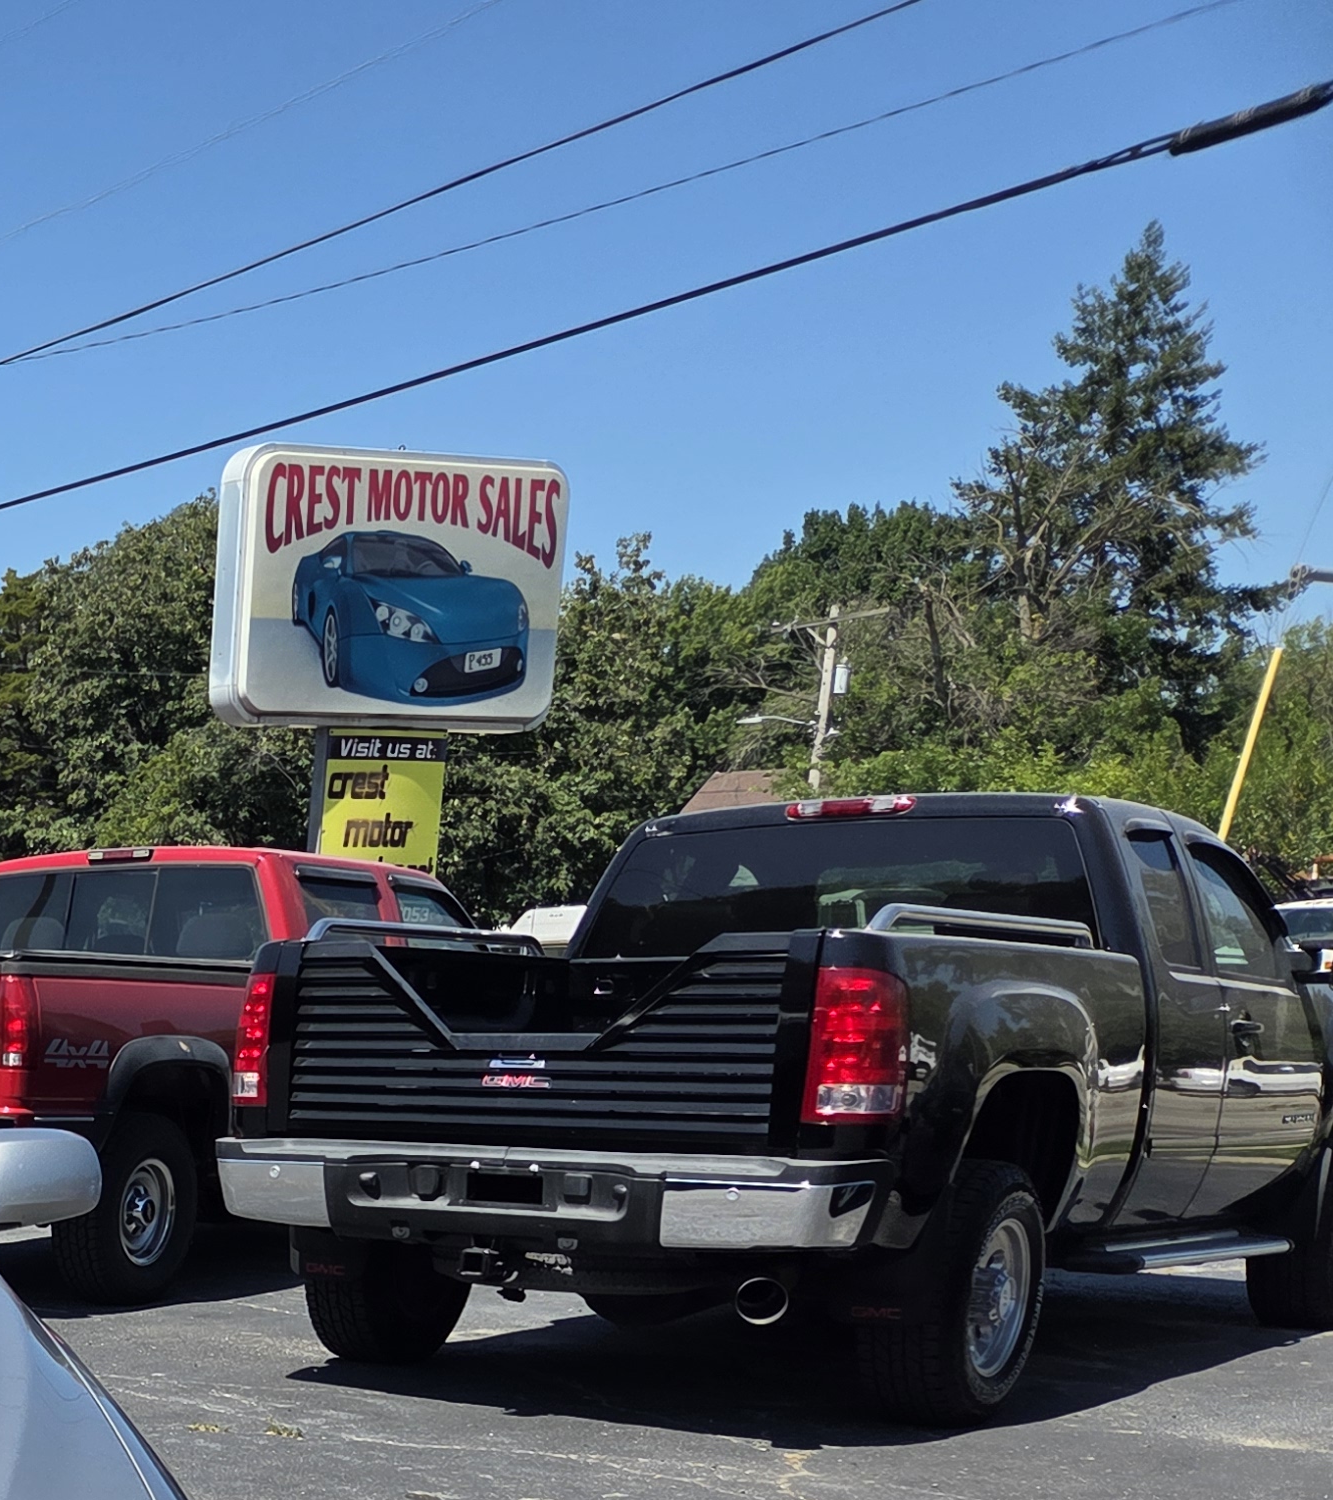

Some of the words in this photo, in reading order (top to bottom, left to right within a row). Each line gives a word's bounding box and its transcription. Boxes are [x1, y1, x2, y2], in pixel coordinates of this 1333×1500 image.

[265, 462, 361, 554] CREST
[367, 468, 470, 528] MOTOR
[476, 474, 561, 570] SALES
[340, 738, 382, 758] Visit
[386, 742, 412, 758] us
[415, 740, 437, 759] at:
[327, 764, 389, 800] crest
[343, 812, 413, 848] motor
[44, 1038, 110, 1069] 4x4
[481, 1074, 552, 1089] GMC
[305, 1262, 346, 1276] GMC
[851, 1306, 902, 1319] GMC
